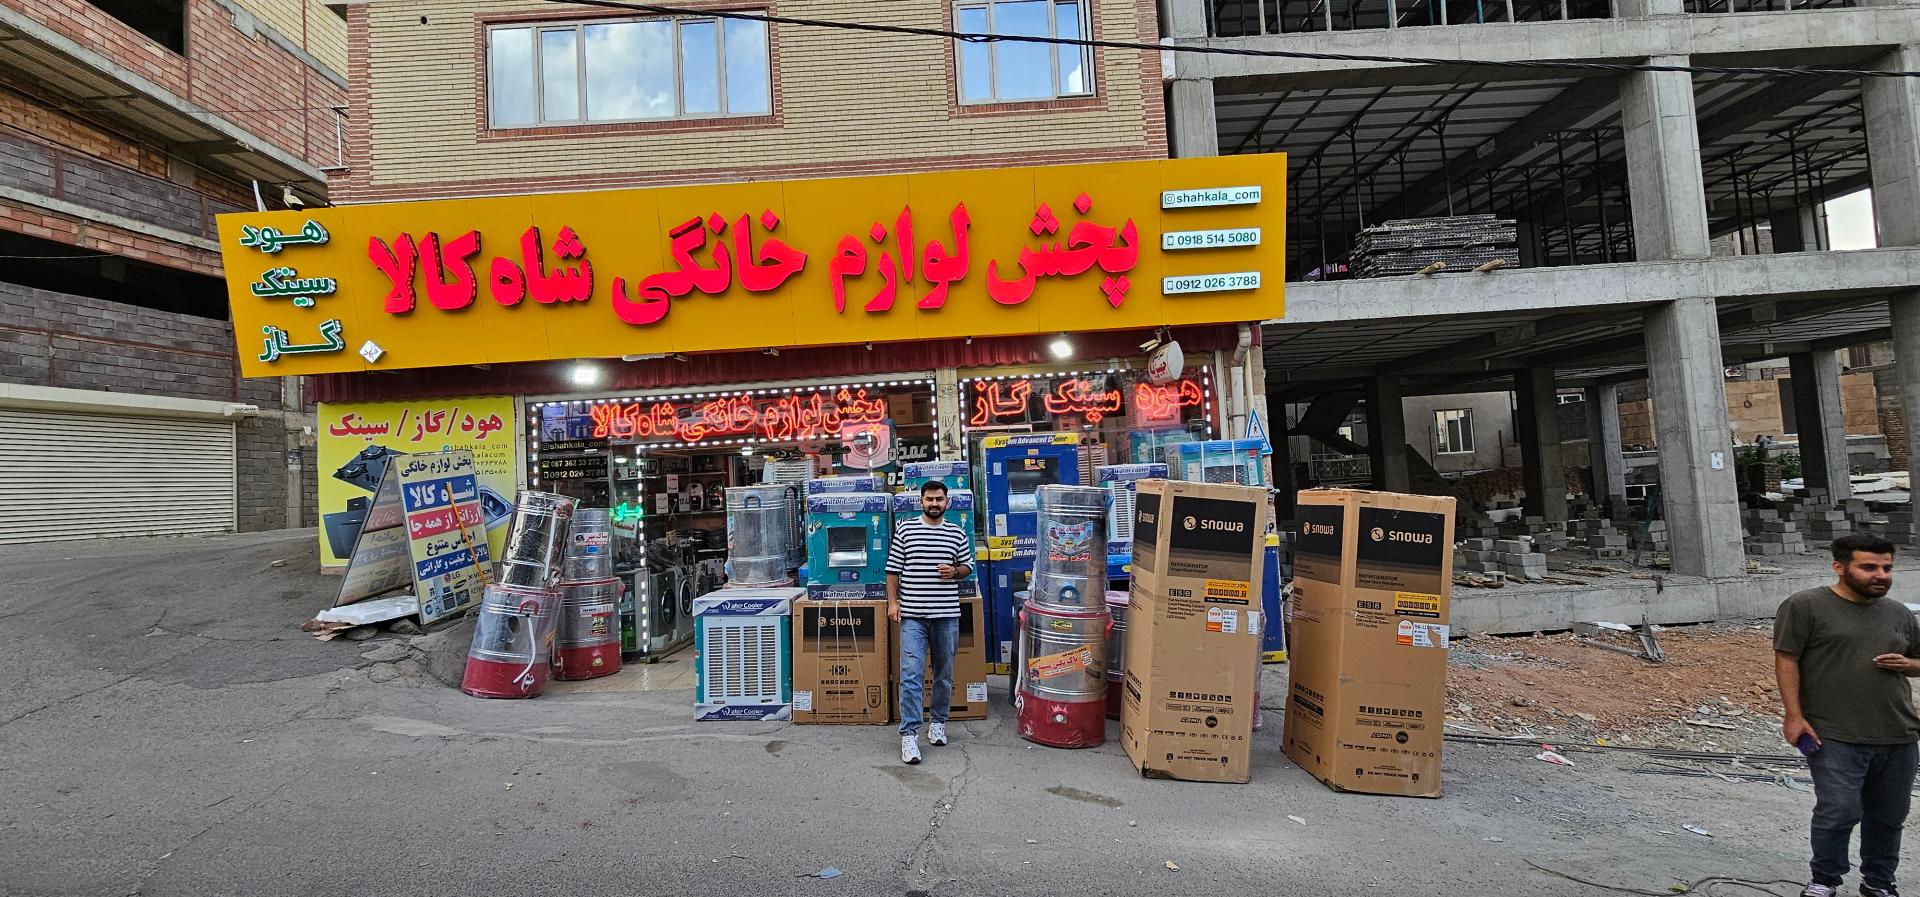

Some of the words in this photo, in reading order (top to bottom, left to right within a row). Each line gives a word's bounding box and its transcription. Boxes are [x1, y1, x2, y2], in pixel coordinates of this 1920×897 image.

[1176, 190, 1260, 204] shahkala_com
[239, 219, 328, 253] هود
[986, 191, 1141, 308] پخش
[1177, 235, 1203, 246] 0918
[1206, 234, 1225, 245] 514
[1228, 232, 1257, 243] 5080
[368, 230, 482, 314] کالا
[490, 225, 593, 306] شاه
[611, 208, 808, 326] خانگی
[829, 200, 971, 314] لوازم
[250, 266, 337, 307] سینک
[1175, 280, 1201, 291] 0912
[1204, 278, 1226, 289] 026
[1228, 275, 1258, 287] 3788
[258, 319, 346, 363] گاز
[823, 389, 886, 434] پخش
[970, 380, 1032, 426] گاز
[1044, 379, 1121, 423] سینک
[1135, 380, 1202, 418] هود
[329, 413, 391, 441] سینک
[410, 410, 446, 442] گاز
[460, 413, 504, 440] هود
[590, 402, 640, 438] کالا
[637, 402, 679, 436] شاه
[681, 394, 758, 442] خانگی
[764, 393, 823, 440] لوازم
[400, 460, 428, 478] خانگی
[430, 457, 451, 475] لوازم
[452, 455, 473, 471] پخش
[409, 483, 436, 508] کالا
[1200, 519, 1244, 532] snowa
[1311, 524, 1334, 535] snowa
[1388, 530, 1433, 544] snowa
[829, 617, 862, 627] snowa
